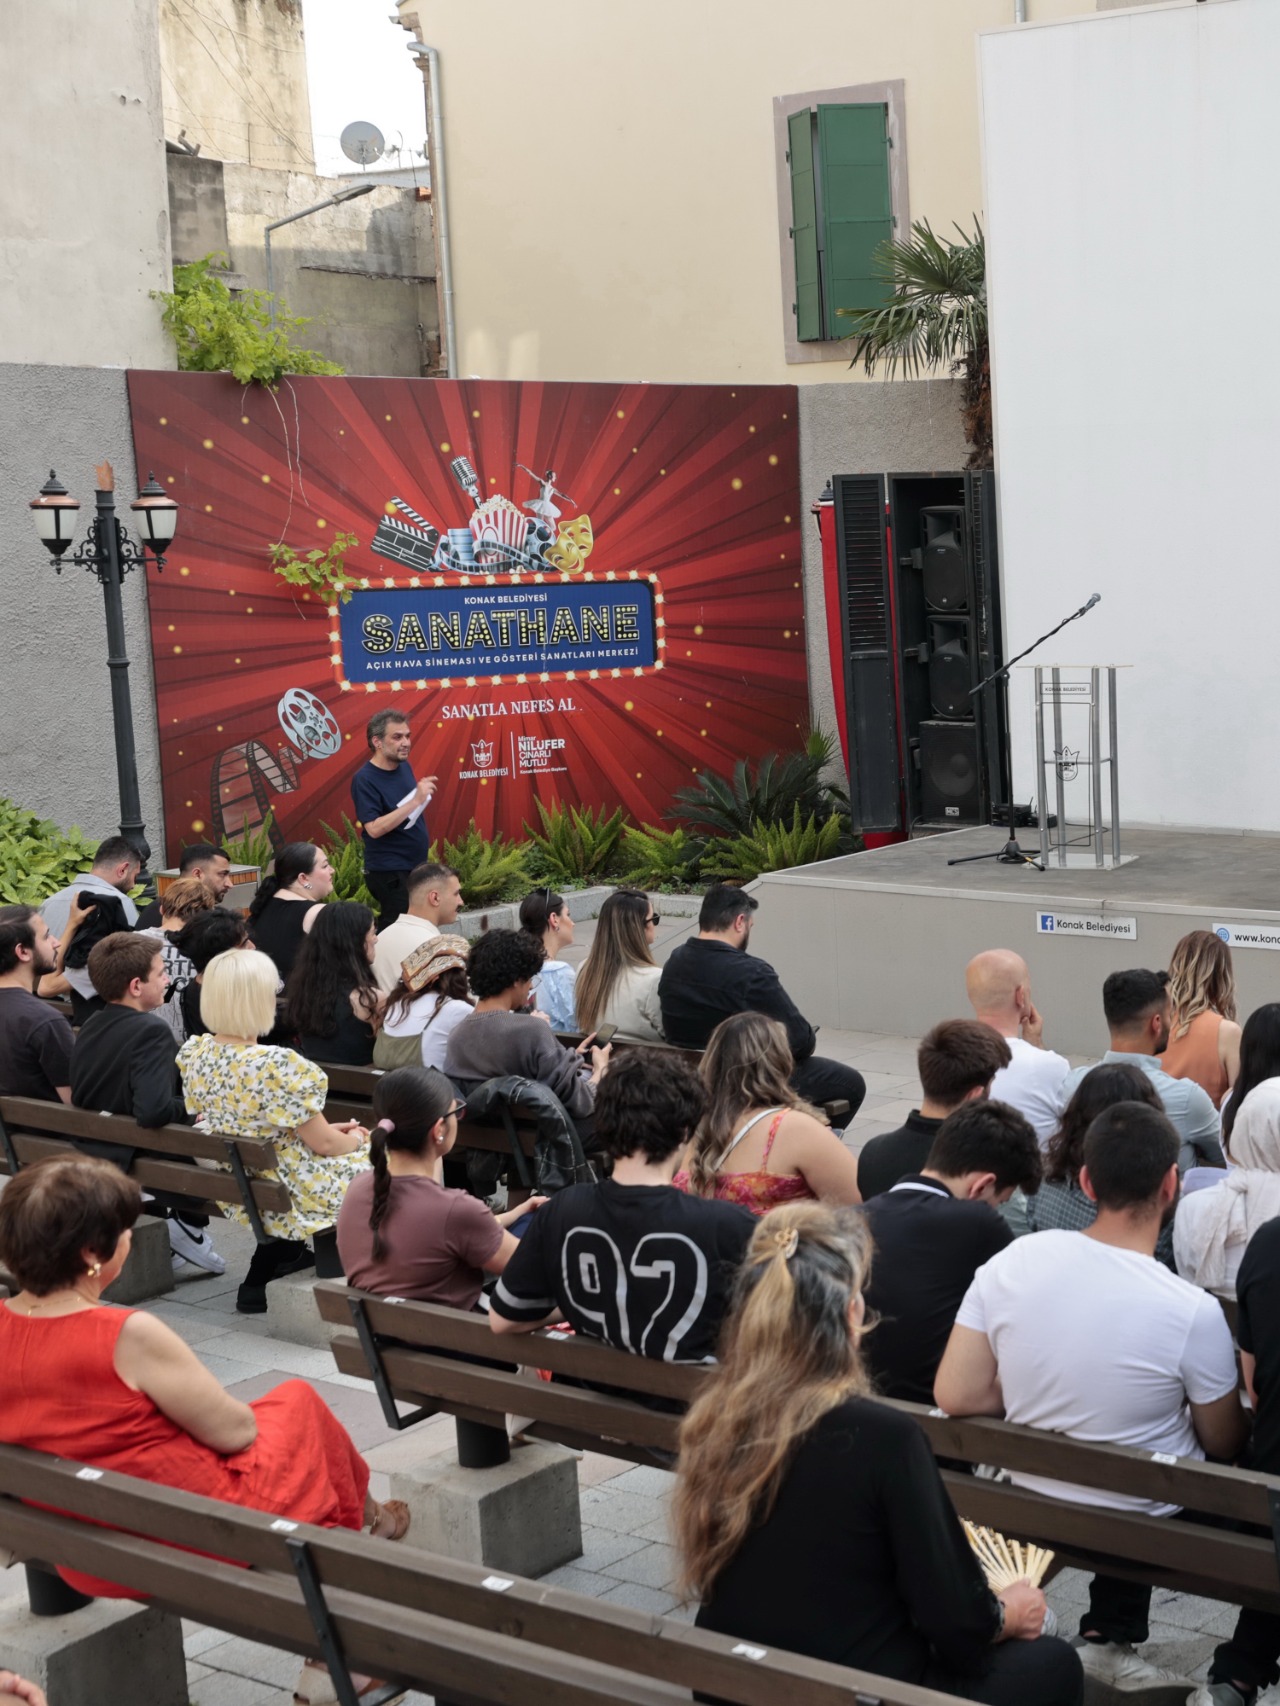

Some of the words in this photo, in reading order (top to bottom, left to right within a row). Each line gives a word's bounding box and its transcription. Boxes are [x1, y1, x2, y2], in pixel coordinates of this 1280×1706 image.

[464, 596, 496, 605] KONAK
[497, 592, 548, 604] BELEDİYESİ
[361, 604, 640, 654] SANATHANE
[366, 661, 392, 671] AÇIK
[395, 660, 422, 668] HAVA
[425, 656, 476, 667] SİNEMASI
[478, 656, 491, 664] VE
[493, 652, 538, 663] GÖSTERİ
[540, 651, 595, 660] SANATLARI
[598, 646, 639, 657] MERKEZİ
[442, 702, 508, 719] SANATLA
[510, 699, 555, 715] NEFES
[520, 758, 548, 768] MUTLU
[459, 771, 479, 779] KONAK
[1056, 919, 1084, 931] Konak
[1086, 921, 1131, 935] Belediyesi
